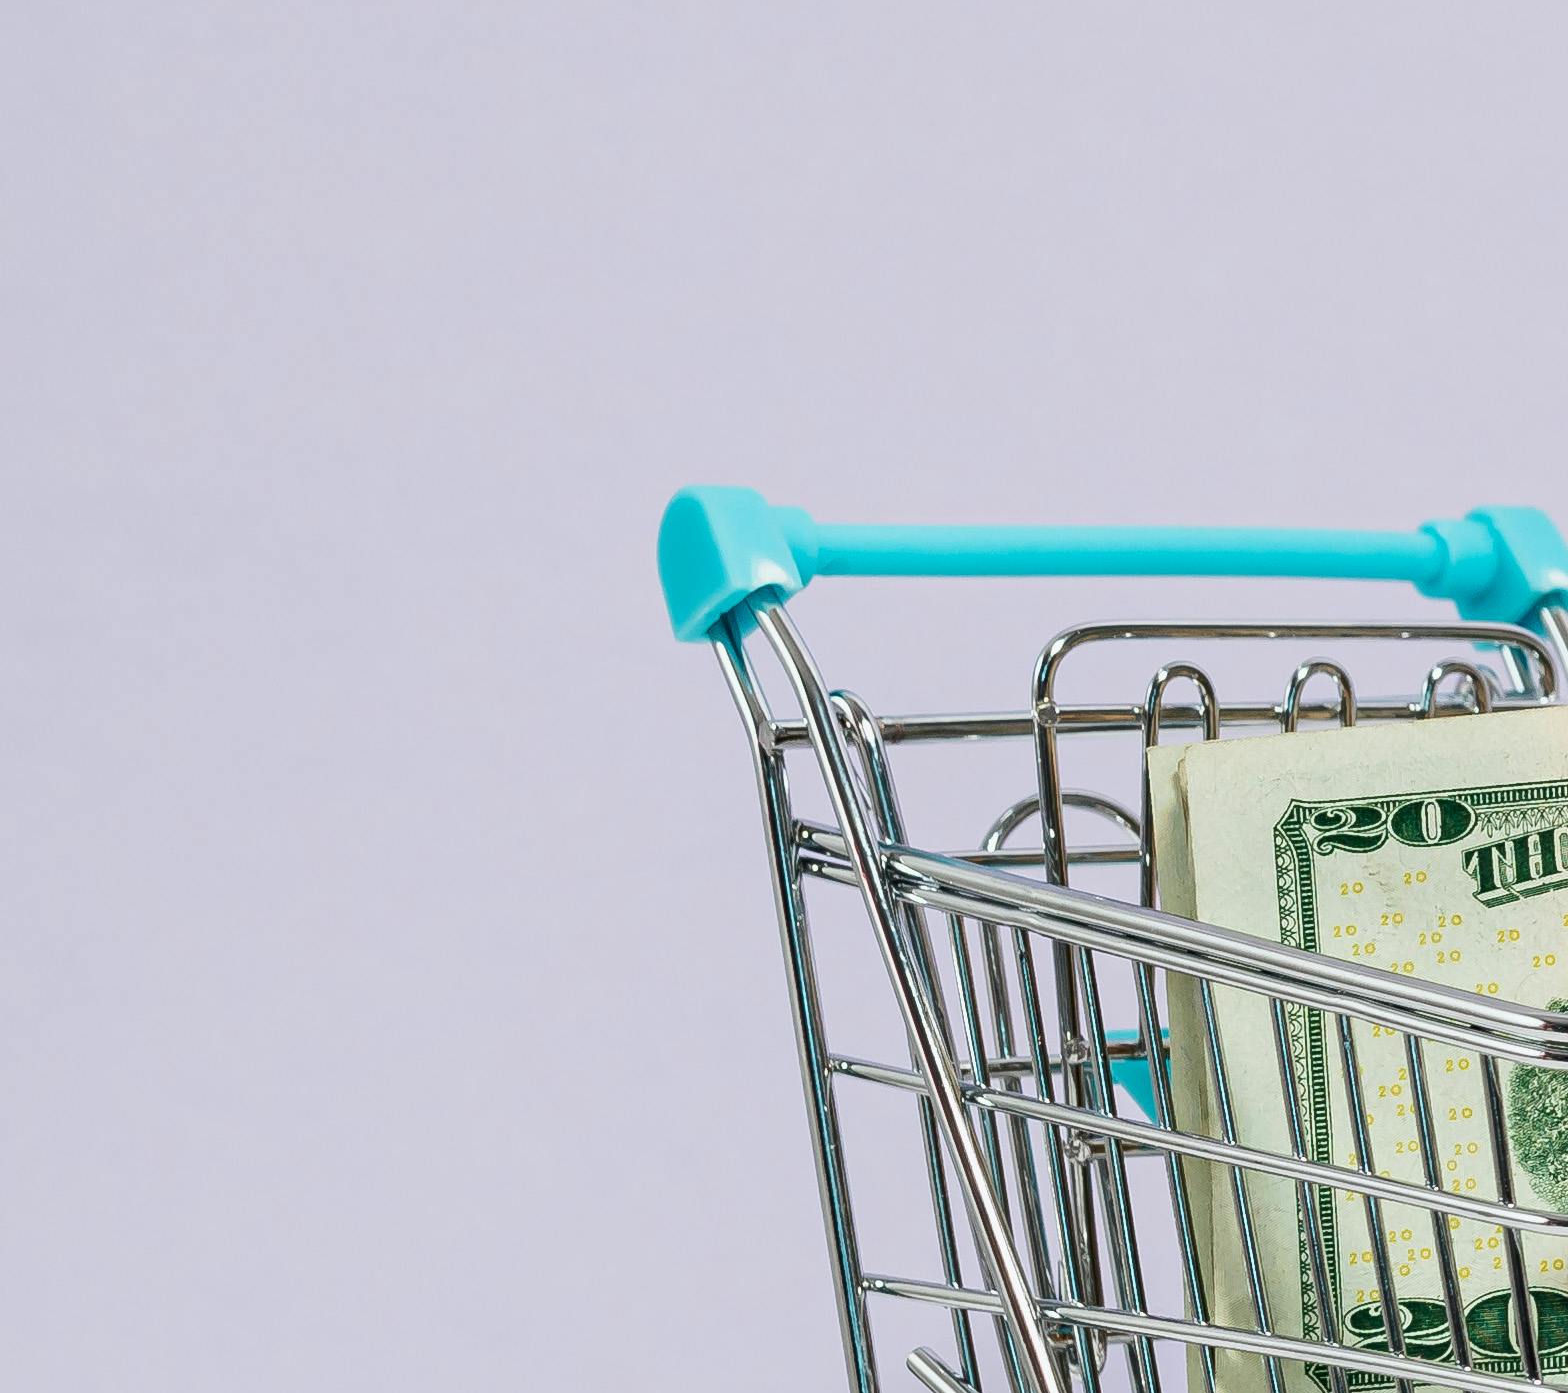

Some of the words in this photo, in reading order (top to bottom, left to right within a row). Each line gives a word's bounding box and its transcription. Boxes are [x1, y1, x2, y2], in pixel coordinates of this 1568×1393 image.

[1309, 798, 1477, 856] 20
[1404, 870, 1427, 886] 20
[1340, 881, 1364, 895] 20
[1381, 911, 1404, 926] 20
[1438, 913, 1463, 927] 20
[1333, 925, 1357, 938] 20
[1419, 931, 1442, 946] 20
[1497, 929, 1520, 943] 20
[1353, 942, 1377, 956] 20
[1437, 950, 1462, 964] 20
[1533, 953, 1557, 969] 20
[1446, 1057, 1470, 1072] 20
[1378, 1083, 1402, 1098] 20
[1449, 1107, 1473, 1121] 20
[1395, 1140, 1420, 1154] 20
[1455, 1142, 1478, 1156] 20
[1453, 1177, 1477, 1193] 20
[1389, 1229, 1413, 1244] 20
[1475, 1236, 1500, 1251] 20
[1349, 1250, 1373, 1265] 20
[1407, 1247, 1431, 1261] 20
[1540, 1258, 1565, 1274] 20
